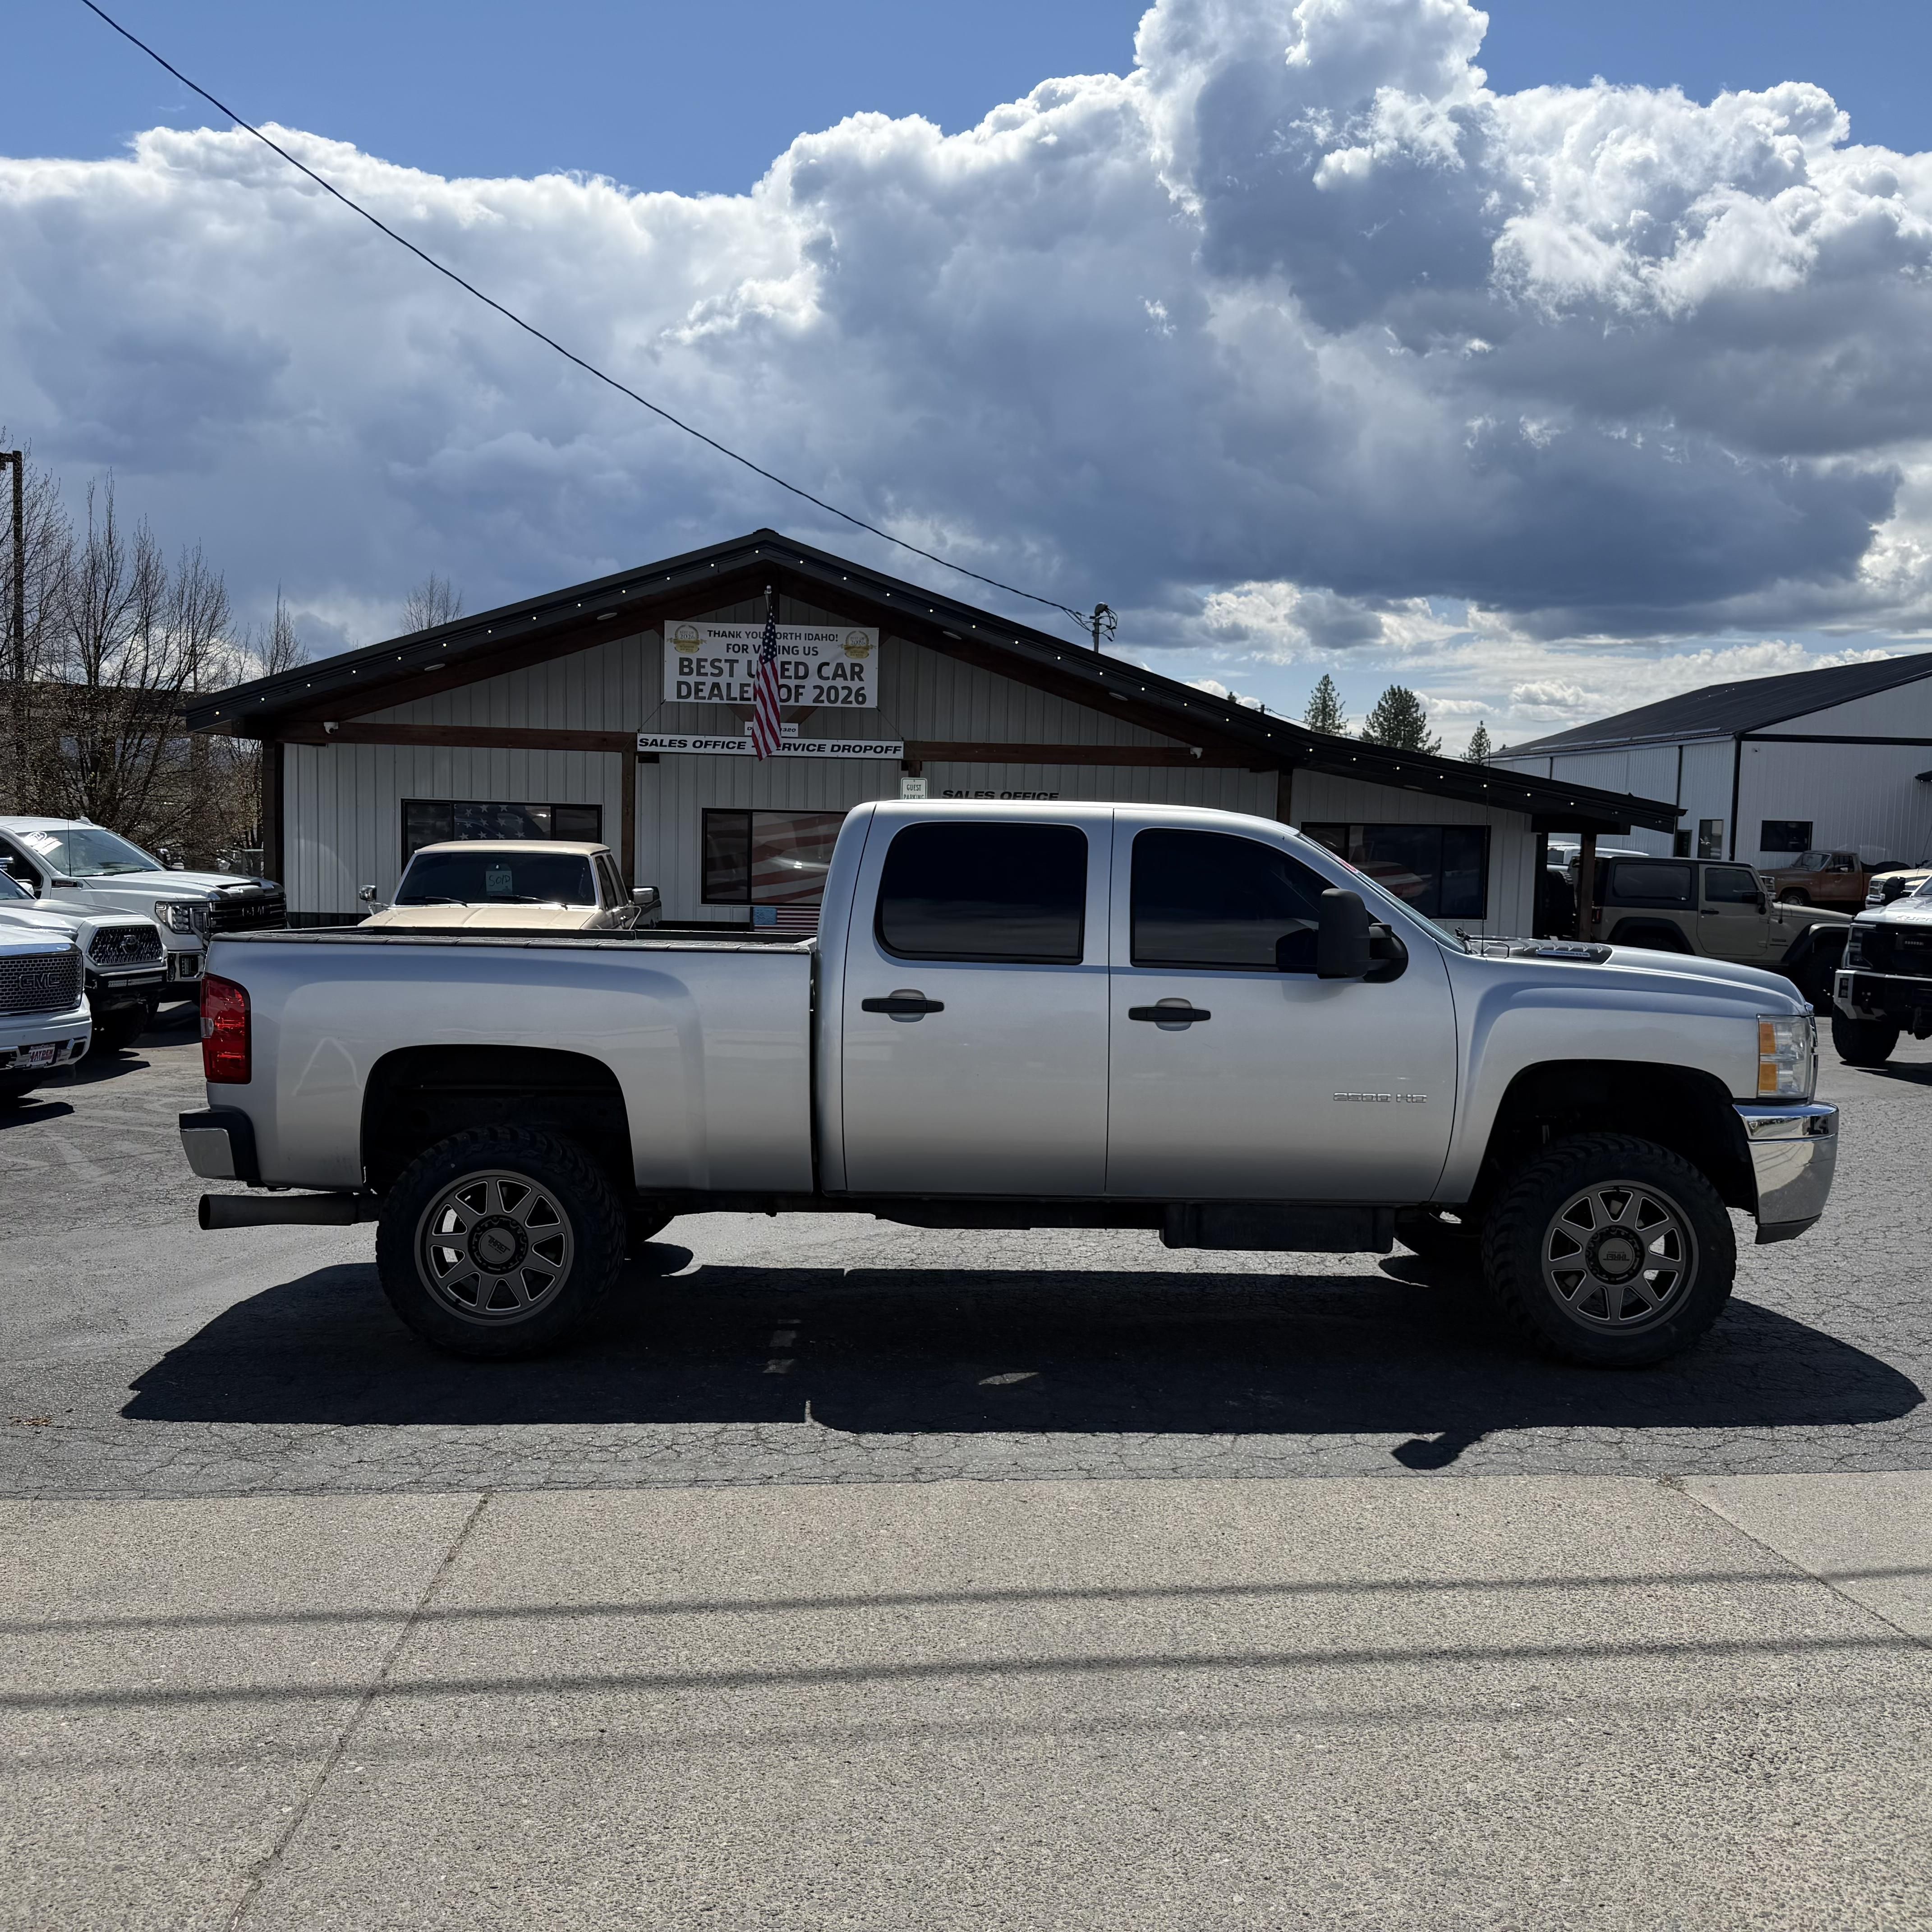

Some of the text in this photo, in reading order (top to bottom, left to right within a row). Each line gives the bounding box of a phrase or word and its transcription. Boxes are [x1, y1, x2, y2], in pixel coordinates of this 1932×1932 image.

[707, 630, 741, 639] THANK
[775, 632, 801, 640] ORTH
[805, 633, 838, 642] IDAHO!
[726, 644, 819, 656] FOR VING US
[679, 657, 864, 681] BEST UED CAR
[676, 681, 866, 705] DEALE OF 2026
[639, 738, 688, 748] SALES
[692, 740, 746, 750] OFFICE
[776, 743, 826, 752] RVICE
[830, 744, 902, 754] DROPOFF
[942, 790, 1059, 800] SALES OFFICE
[18, 973, 60, 989] GMC
[1334, 1092, 1427, 1103] 2500 HD
